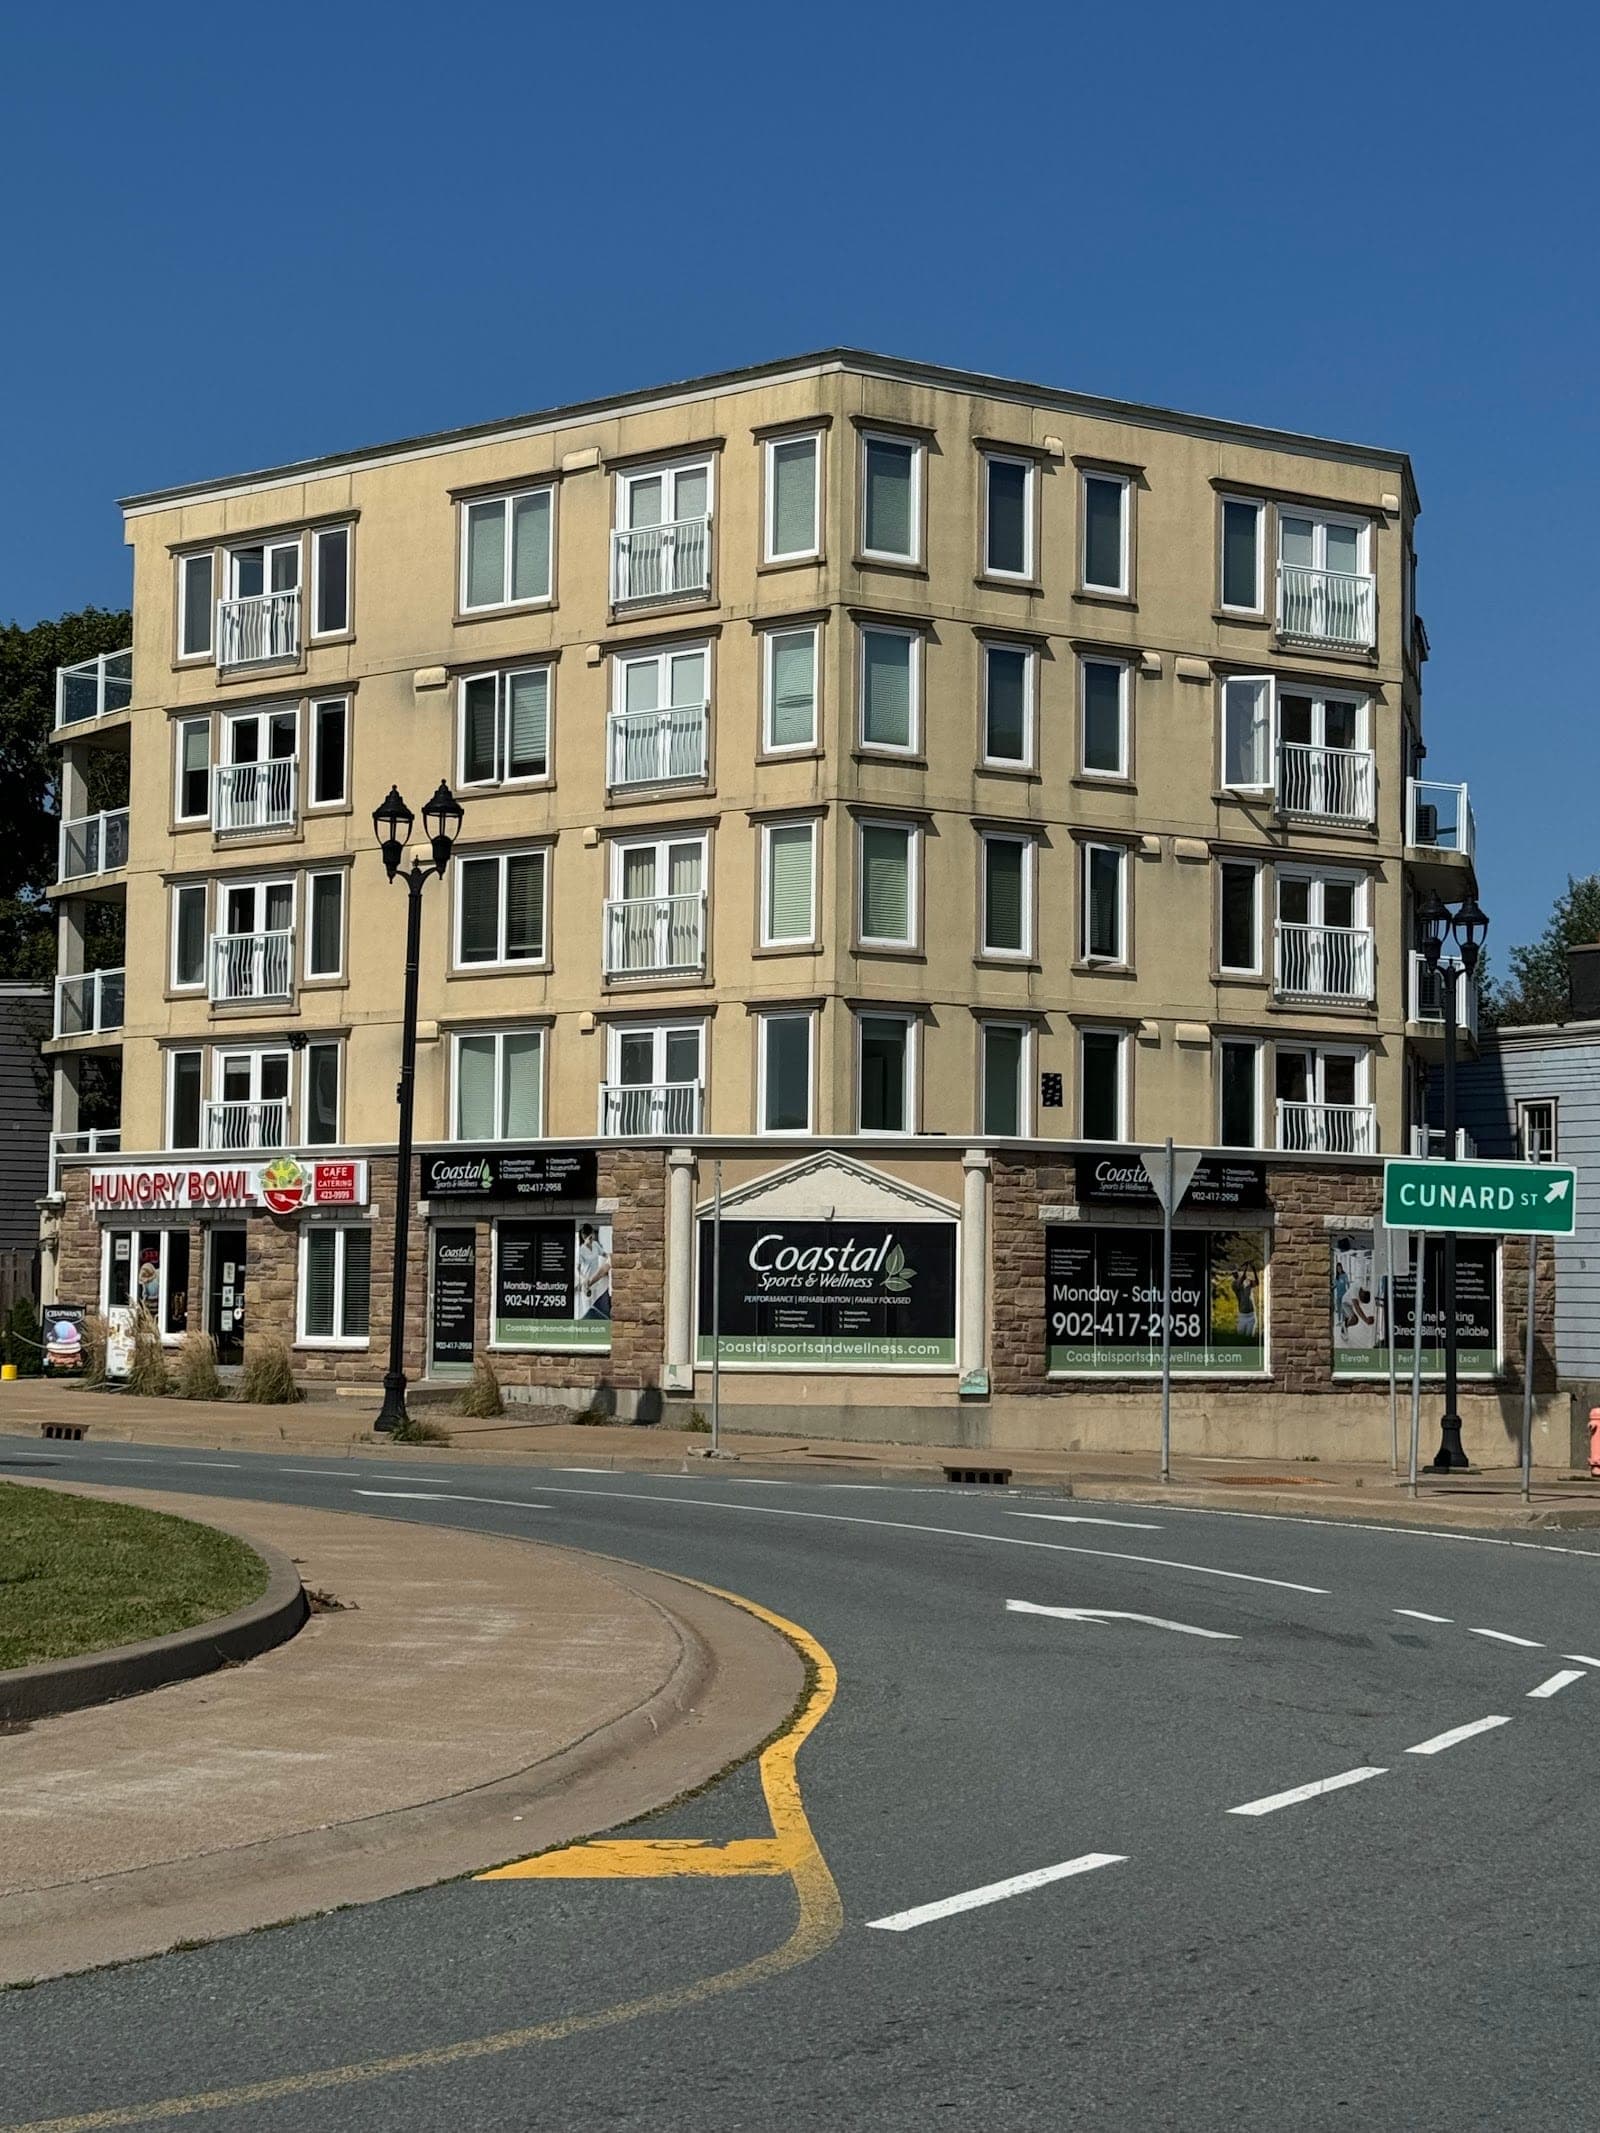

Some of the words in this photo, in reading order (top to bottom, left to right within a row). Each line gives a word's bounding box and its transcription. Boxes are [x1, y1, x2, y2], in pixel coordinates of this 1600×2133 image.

[323, 1167, 348, 1177] CAFE
[431, 1158, 486, 1180] Coastal
[1095, 1161, 1151, 1182] Coasta
[92, 1173, 181, 1202] HUNGRY
[188, 1171, 255, 1200] BOWL
[1400, 1183, 1514, 1210] CUNARD
[1521, 1193, 1538, 1206] ST
[439, 1245, 471, 1258] Coastal
[748, 1234, 893, 1272] Coastal
[503, 1281, 532, 1291] Monday
[536, 1282, 568, 1292] Saturday
[758, 1272, 803, 1291] Sports
[804, 1272, 817, 1287] &
[819, 1273, 874, 1289] Wellness
[504, 1294, 567, 1307] 902-417-2958
[744, 1295, 795, 1304] PERFORMANCE
[798, 1295, 851, 1304] REHABILITATION
[854, 1296, 878, 1304] FAMILY
[878, 1296, 912, 1304] FOCUSED
[1053, 1284, 1119, 1306] Monday
[1131, 1286, 1201, 1307] Satuday
[1052, 1312, 1201, 1337] 902-417-2958
[1407, 1310, 1437, 1322] Oine
[1439, 1310, 1474, 1325] Bking
[1392, 1325, 1416, 1336] Direc
[1420, 1325, 1447, 1338] Billing
[1456, 1326, 1489, 1337] vailable
[717, 1340, 940, 1356] Coastalsportsandwellness.com
[1398, 1354, 1428, 1363] Perfm
